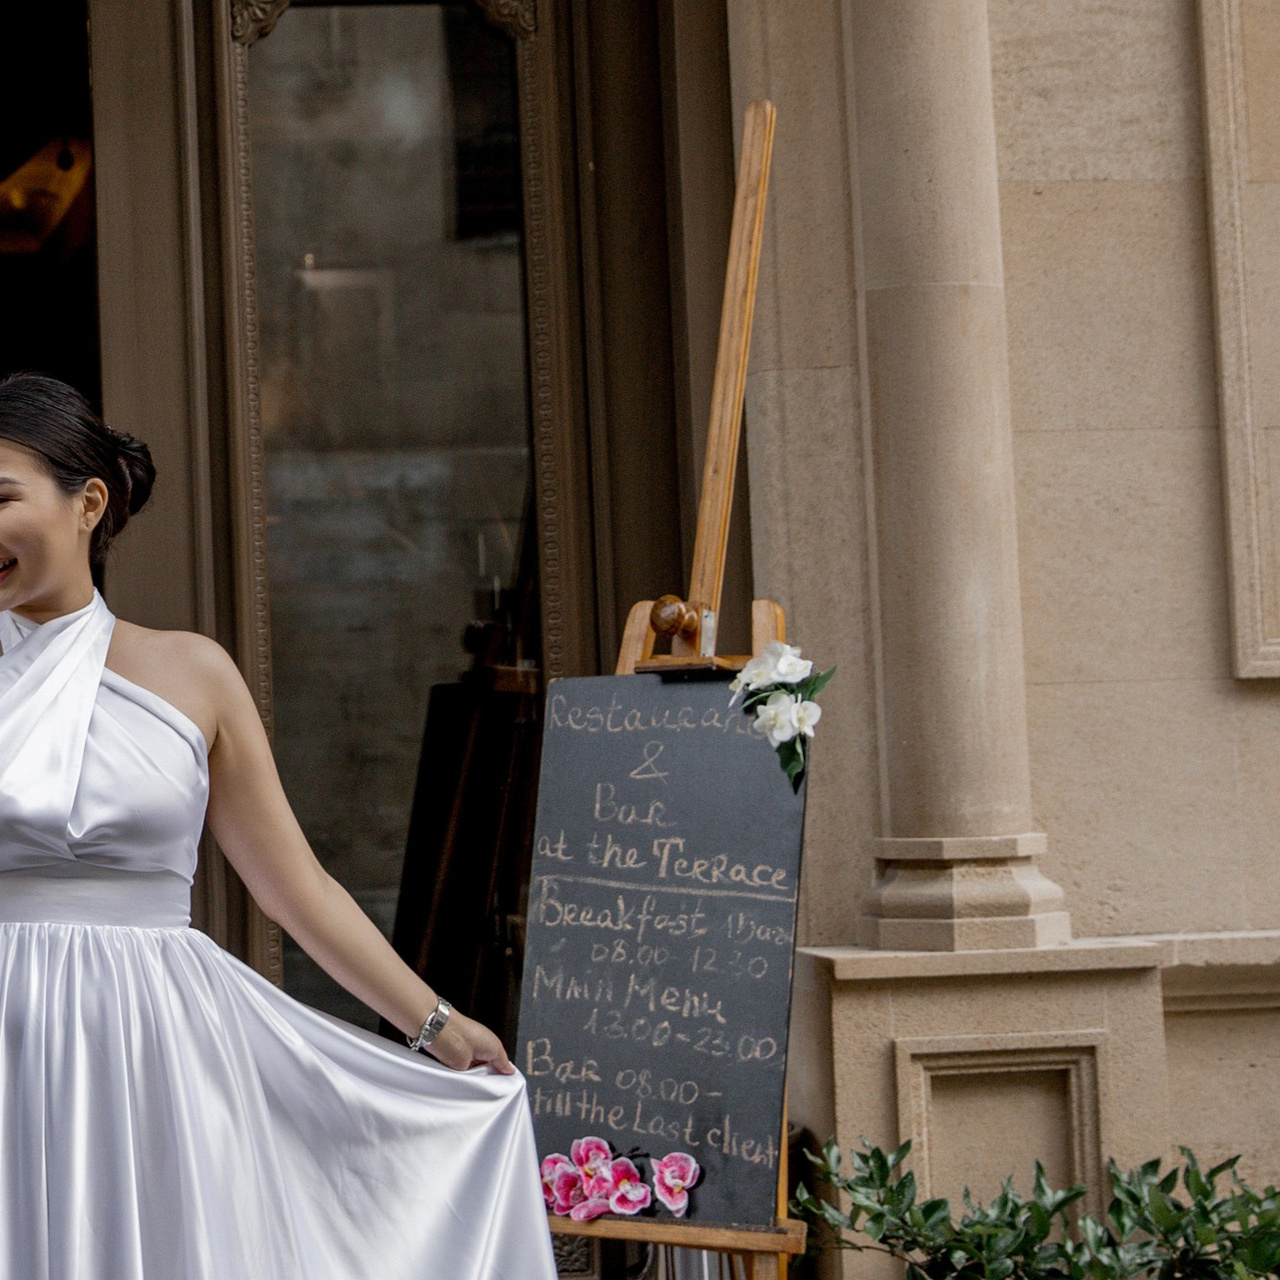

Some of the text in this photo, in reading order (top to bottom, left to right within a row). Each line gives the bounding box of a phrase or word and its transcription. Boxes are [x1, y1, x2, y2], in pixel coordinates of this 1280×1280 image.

[628, 740, 670, 785] &
[537, 829, 574, 861] at
[586, 831, 648, 869] the
[537, 877, 709, 944] Breakfast
[622, 972, 727, 1025] Menu
[532, 1086, 571, 1117] till
[576, 1088, 629, 1131] the
